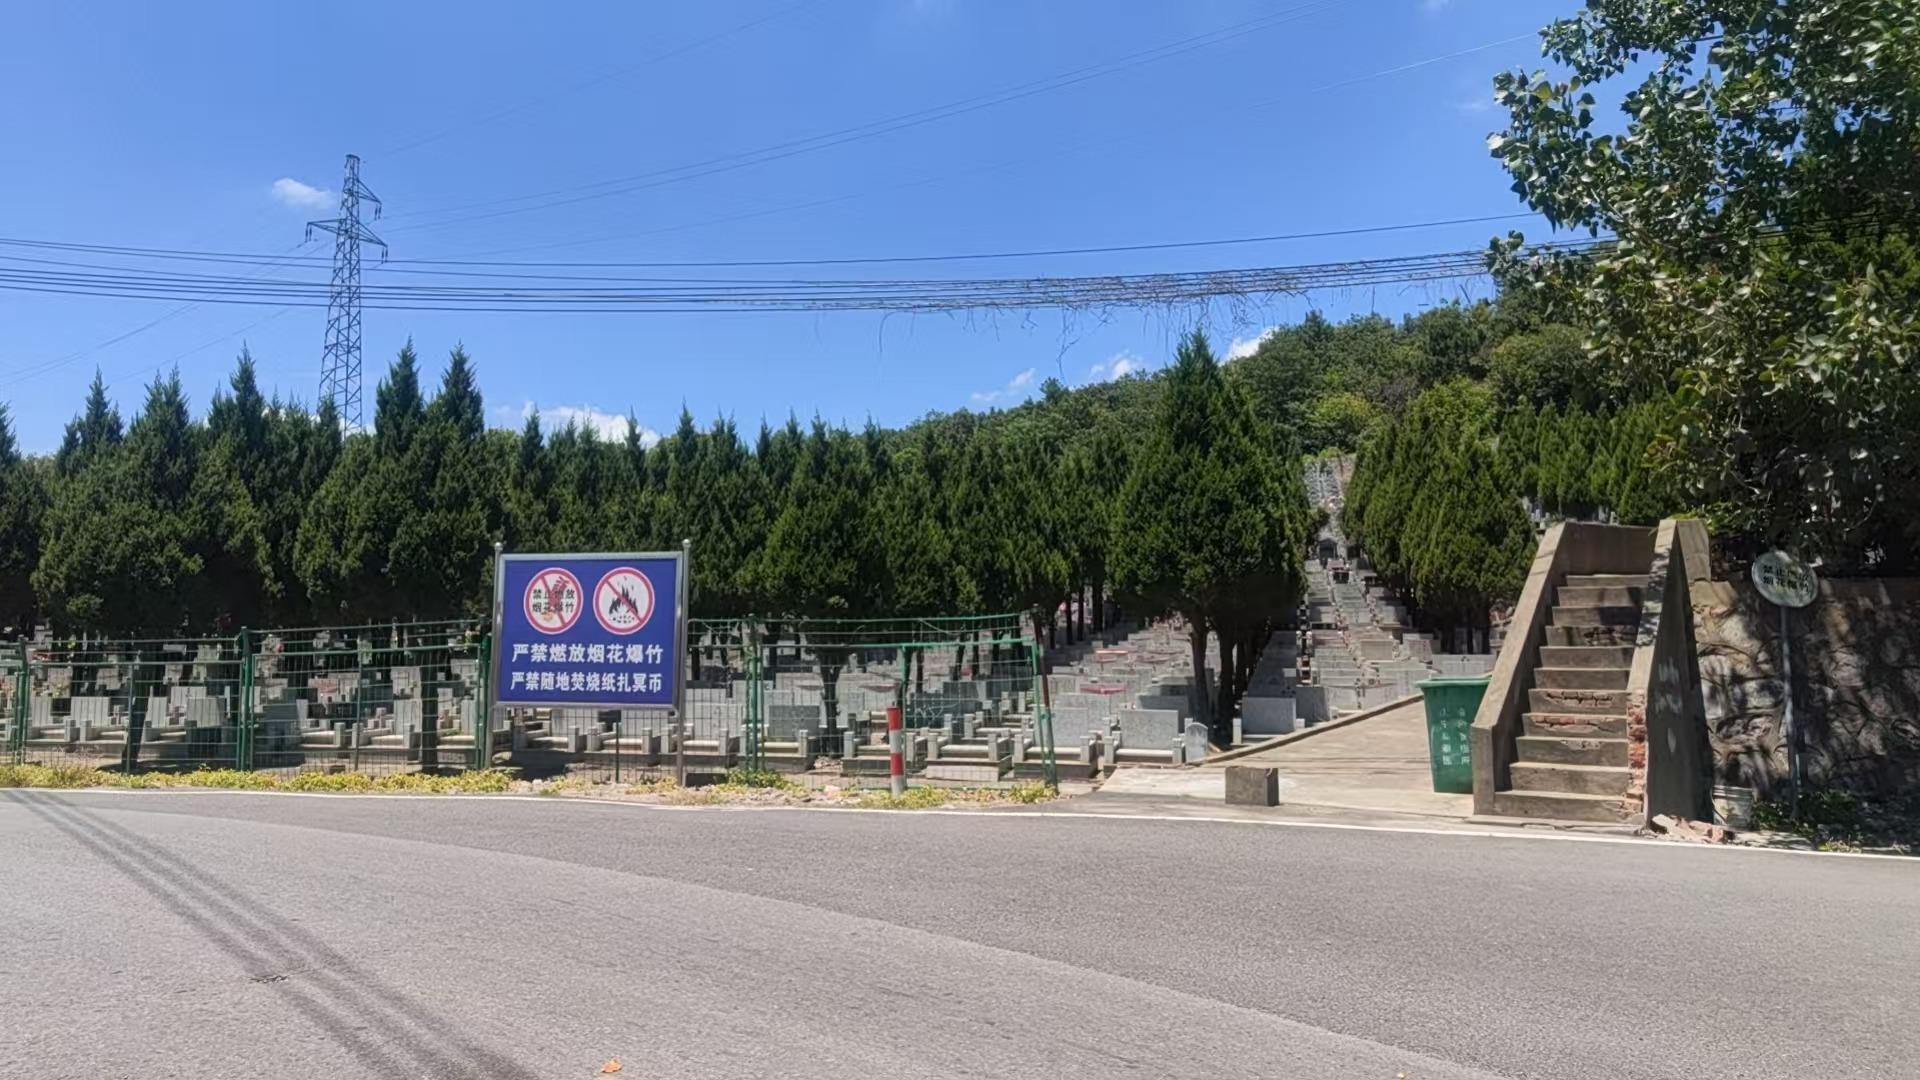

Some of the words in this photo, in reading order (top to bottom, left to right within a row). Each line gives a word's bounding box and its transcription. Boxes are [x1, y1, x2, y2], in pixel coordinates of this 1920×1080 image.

[511, 643, 664, 664] 严禁燃放烟花爆竹
[510, 671, 663, 693] 严禁随地焚烧纸扎冥币
